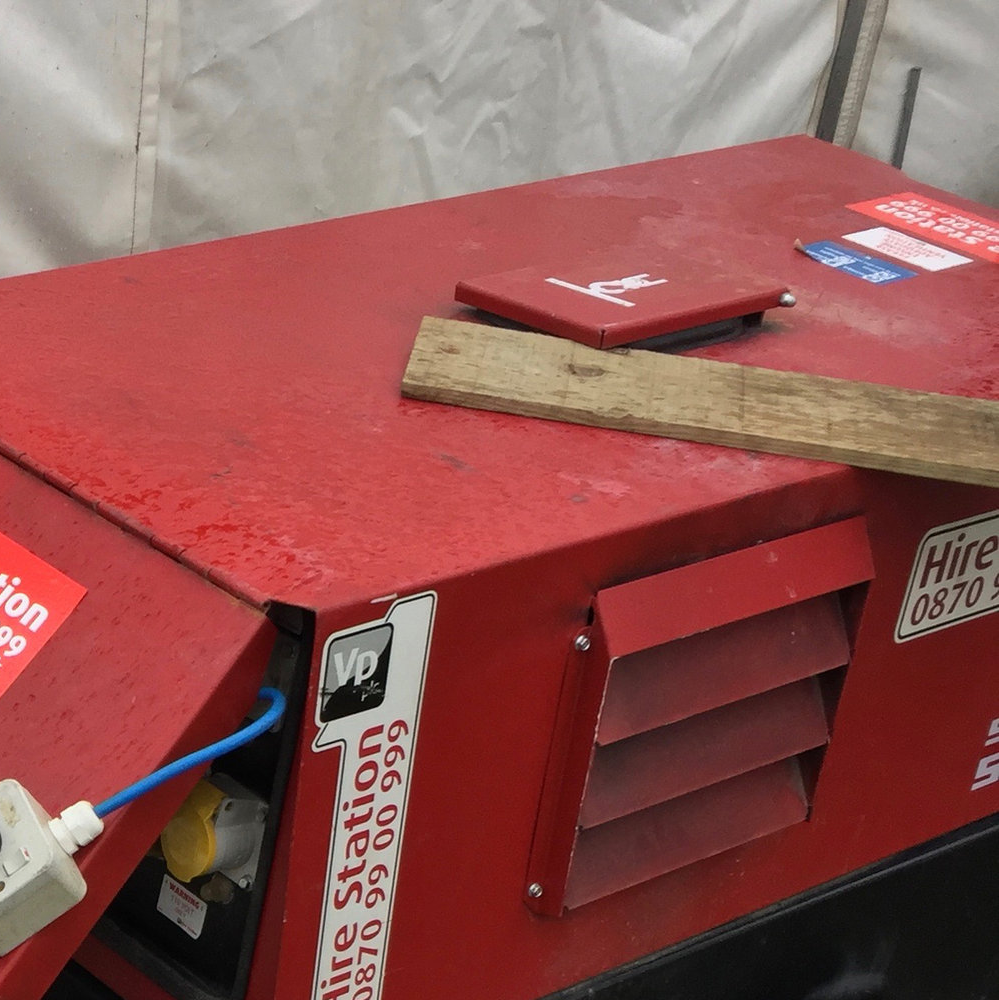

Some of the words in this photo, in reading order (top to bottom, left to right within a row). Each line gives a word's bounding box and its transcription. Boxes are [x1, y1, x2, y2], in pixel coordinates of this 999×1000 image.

[919, 532, 999, 589] Hire
[911, 576, 985, 626] 0870
[334, 647, 379, 687] Vp
[381, 719, 409, 791] 999
[334, 724, 385, 914] Station
[373, 803, 399, 852] 00
[169, 881, 202, 910] WARNING
[365, 863, 390, 909] 99
